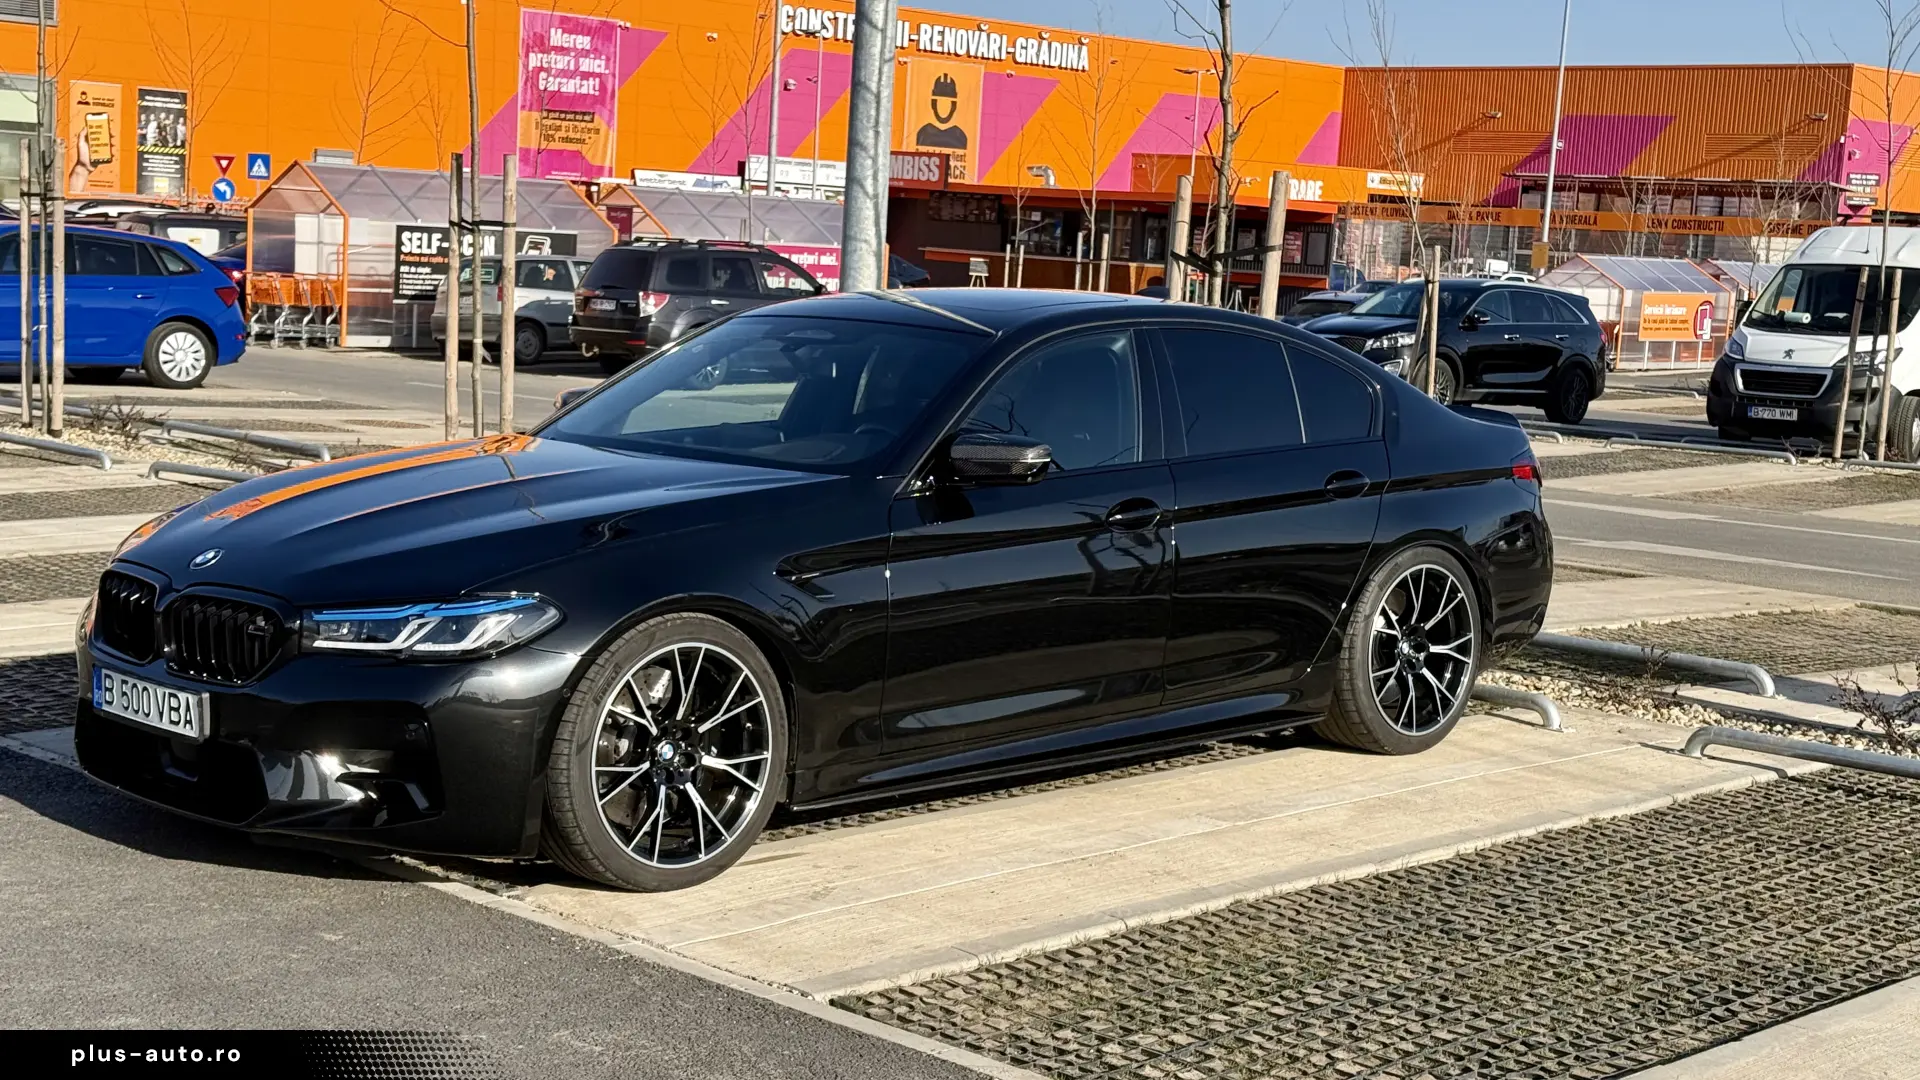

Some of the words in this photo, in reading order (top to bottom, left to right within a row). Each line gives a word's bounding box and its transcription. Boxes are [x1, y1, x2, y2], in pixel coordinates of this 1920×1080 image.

[550, 27, 591, 50] Mereu
[528, 51, 575, 73] prețuri
[579, 54, 609, 74] mici.
[539, 71, 600, 96] Garantat!
[889, 154, 940, 182] MBISS
[1671, 218, 1725, 234] CONSTRUCȚII
[104, 673, 115, 706] B
[121, 679, 152, 719] 500
[155, 687, 194, 732] VBA
